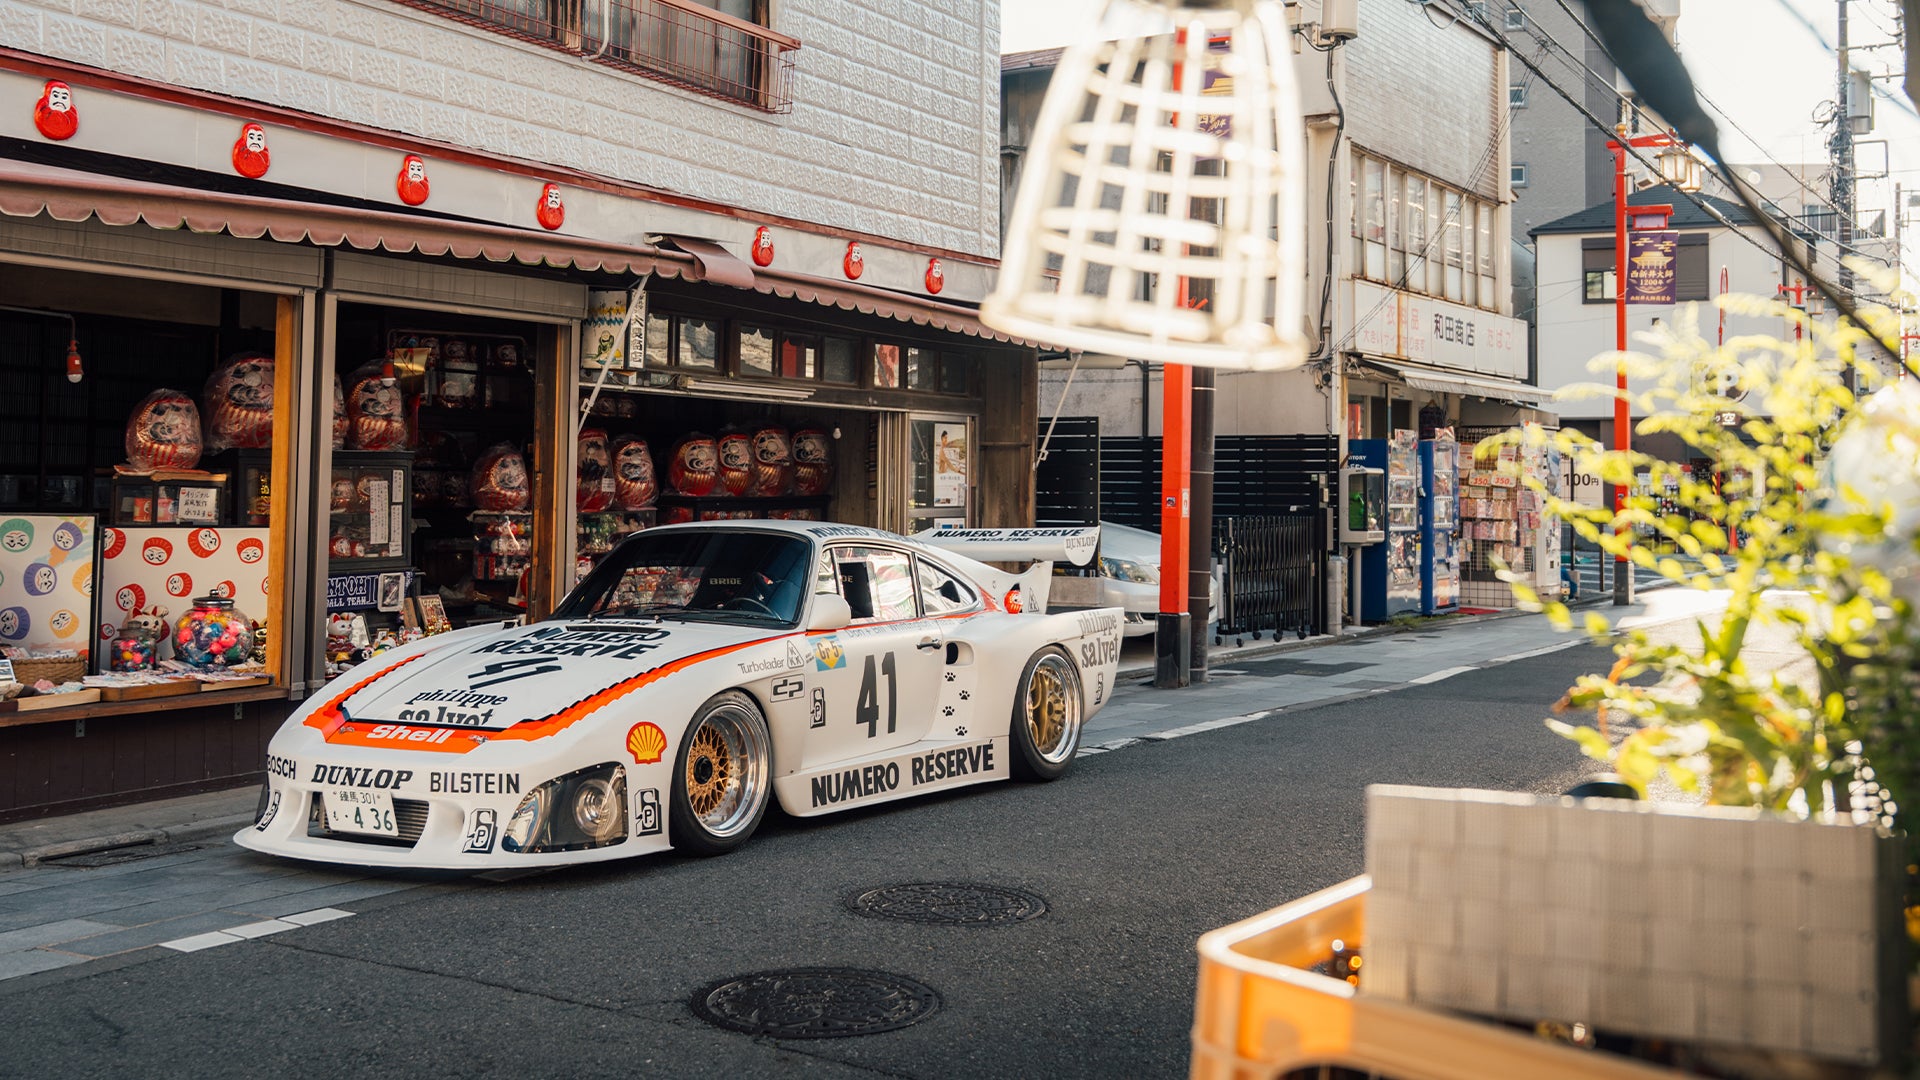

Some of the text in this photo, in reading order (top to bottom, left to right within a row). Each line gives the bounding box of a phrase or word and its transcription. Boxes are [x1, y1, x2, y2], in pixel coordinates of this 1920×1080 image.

[1630, 270, 1674, 279] 西新井大師
[1362, 329, 1426, 352] 大きいサイあります
[1433, 313, 1475, 347] 和田商店
[1487, 327, 1512, 350] たばこ
[1563, 473, 1599, 487] 100円
[932, 530, 1002, 538] NUMERO
[1065, 536, 1097, 551] DUNLOP
[709, 577, 744, 585] BRIDE
[1081, 634, 1119, 668] salvet
[738, 657, 785, 675] Turbolader
[405, 689, 508, 709] philippe
[855, 651, 898, 740] 41
[365, 724, 455, 745] Shell
[311, 764, 413, 790] DUNLOP
[430, 771, 520, 794] BILSTEIN
[811, 762, 900, 808] NUMERO
